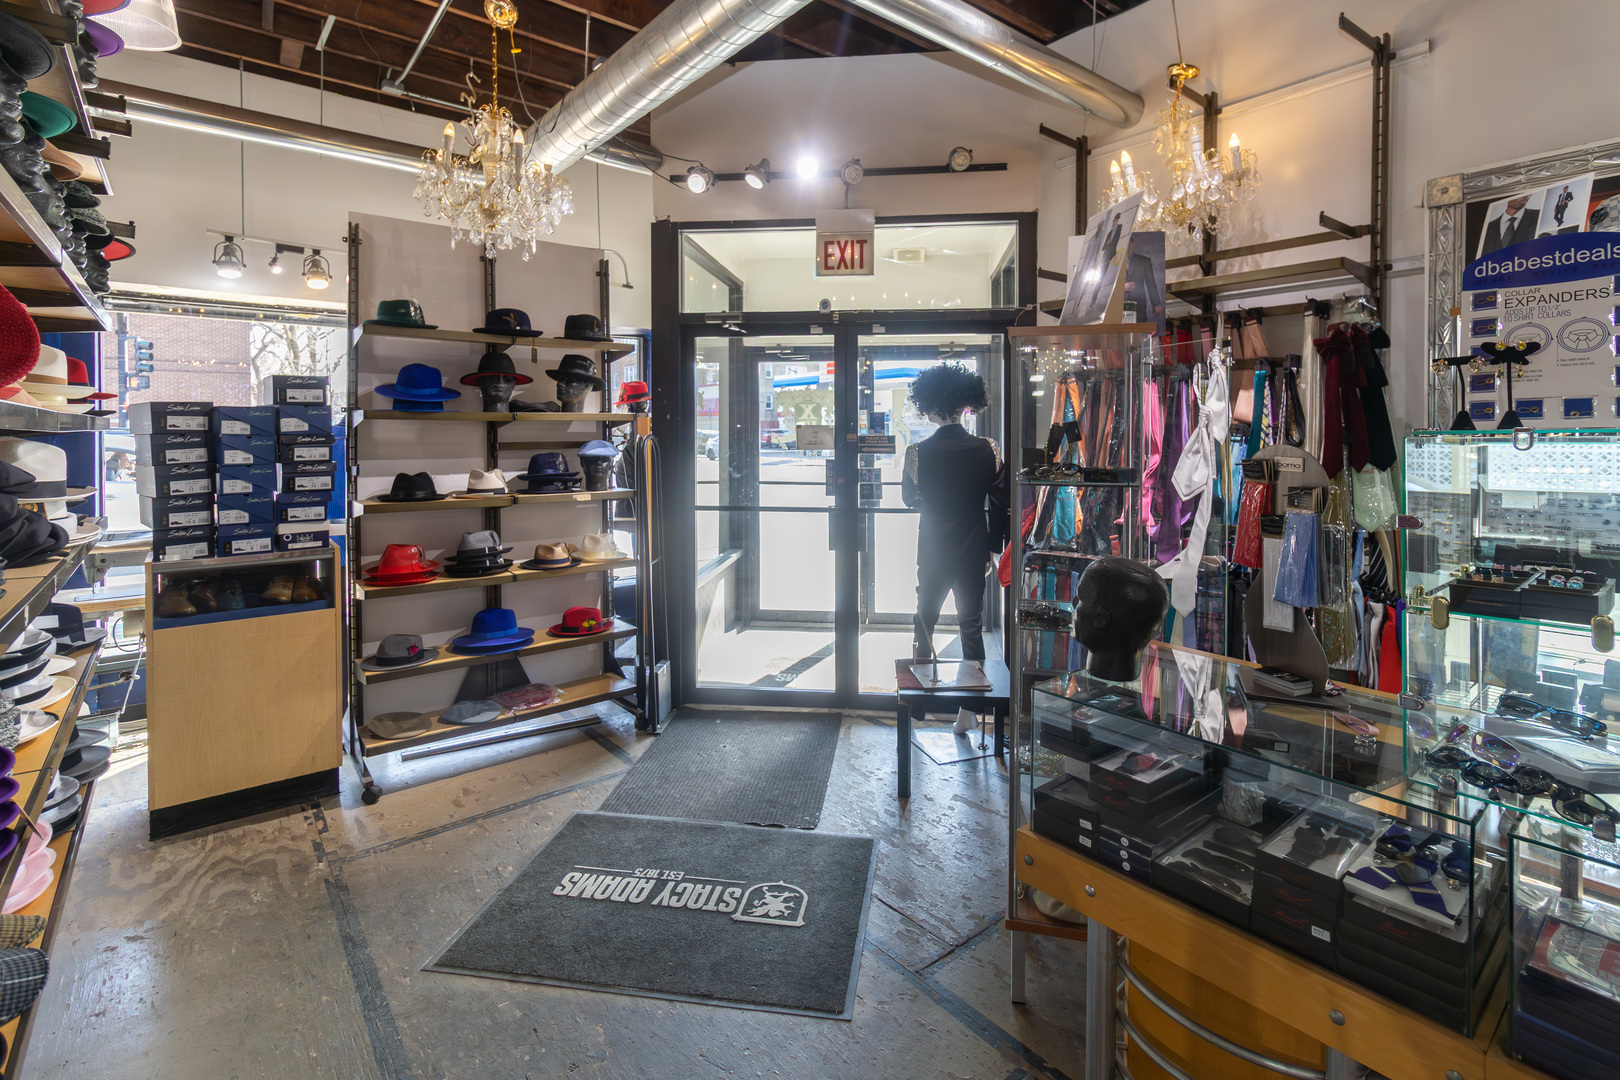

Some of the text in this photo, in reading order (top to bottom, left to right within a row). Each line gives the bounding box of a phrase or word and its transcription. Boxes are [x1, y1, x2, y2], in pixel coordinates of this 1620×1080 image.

[824, 239, 868, 271] EXIT
[1474, 242, 1620, 278] dbabestdeals
[1504, 287, 1541, 298] COLLAR
[1504, 287, 1610, 309] EXPANDERS
[1504, 308, 1524, 316] ADDS
[1525, 306, 1536, 314] UP
[1538, 305, 1547, 313] TO
[1513, 313, 1534, 322] SHIRT
[1537, 309, 1572, 320] COLLARS
[632, 867, 660, 878] 1875
[552, 871, 743, 913] STACY ADAMS
